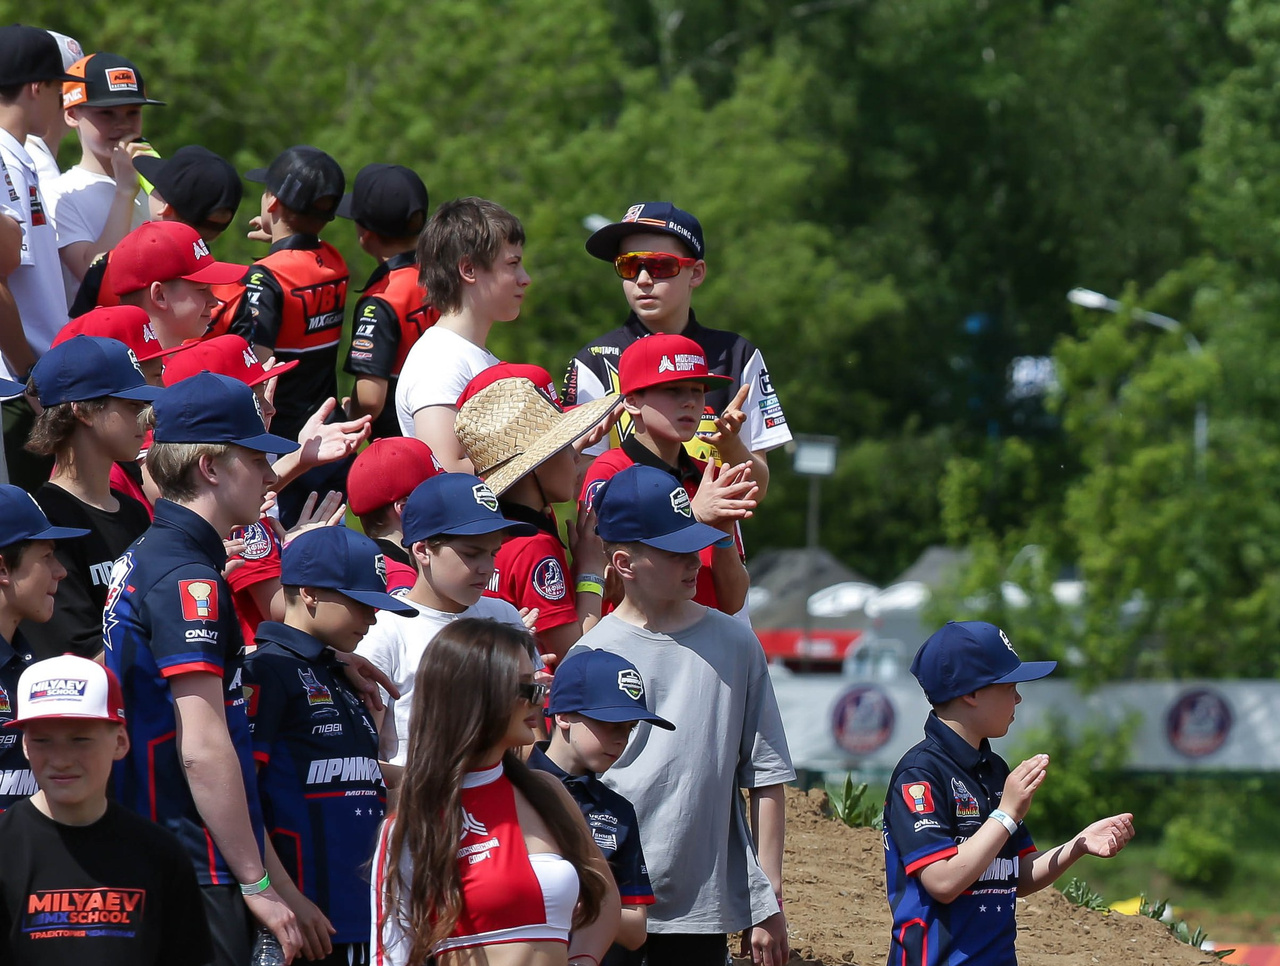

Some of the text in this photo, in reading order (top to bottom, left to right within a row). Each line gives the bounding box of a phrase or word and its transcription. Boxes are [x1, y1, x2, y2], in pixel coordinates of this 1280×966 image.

[669, 221, 692, 240] RACING
[676, 362, 695, 371] СПОРТ
[566, 367, 578, 403] DRINK
[31, 680, 86, 693] MILYAEV
[468, 850, 491, 864] СПОРТ
[28, 892, 141, 914] MILYAEV
